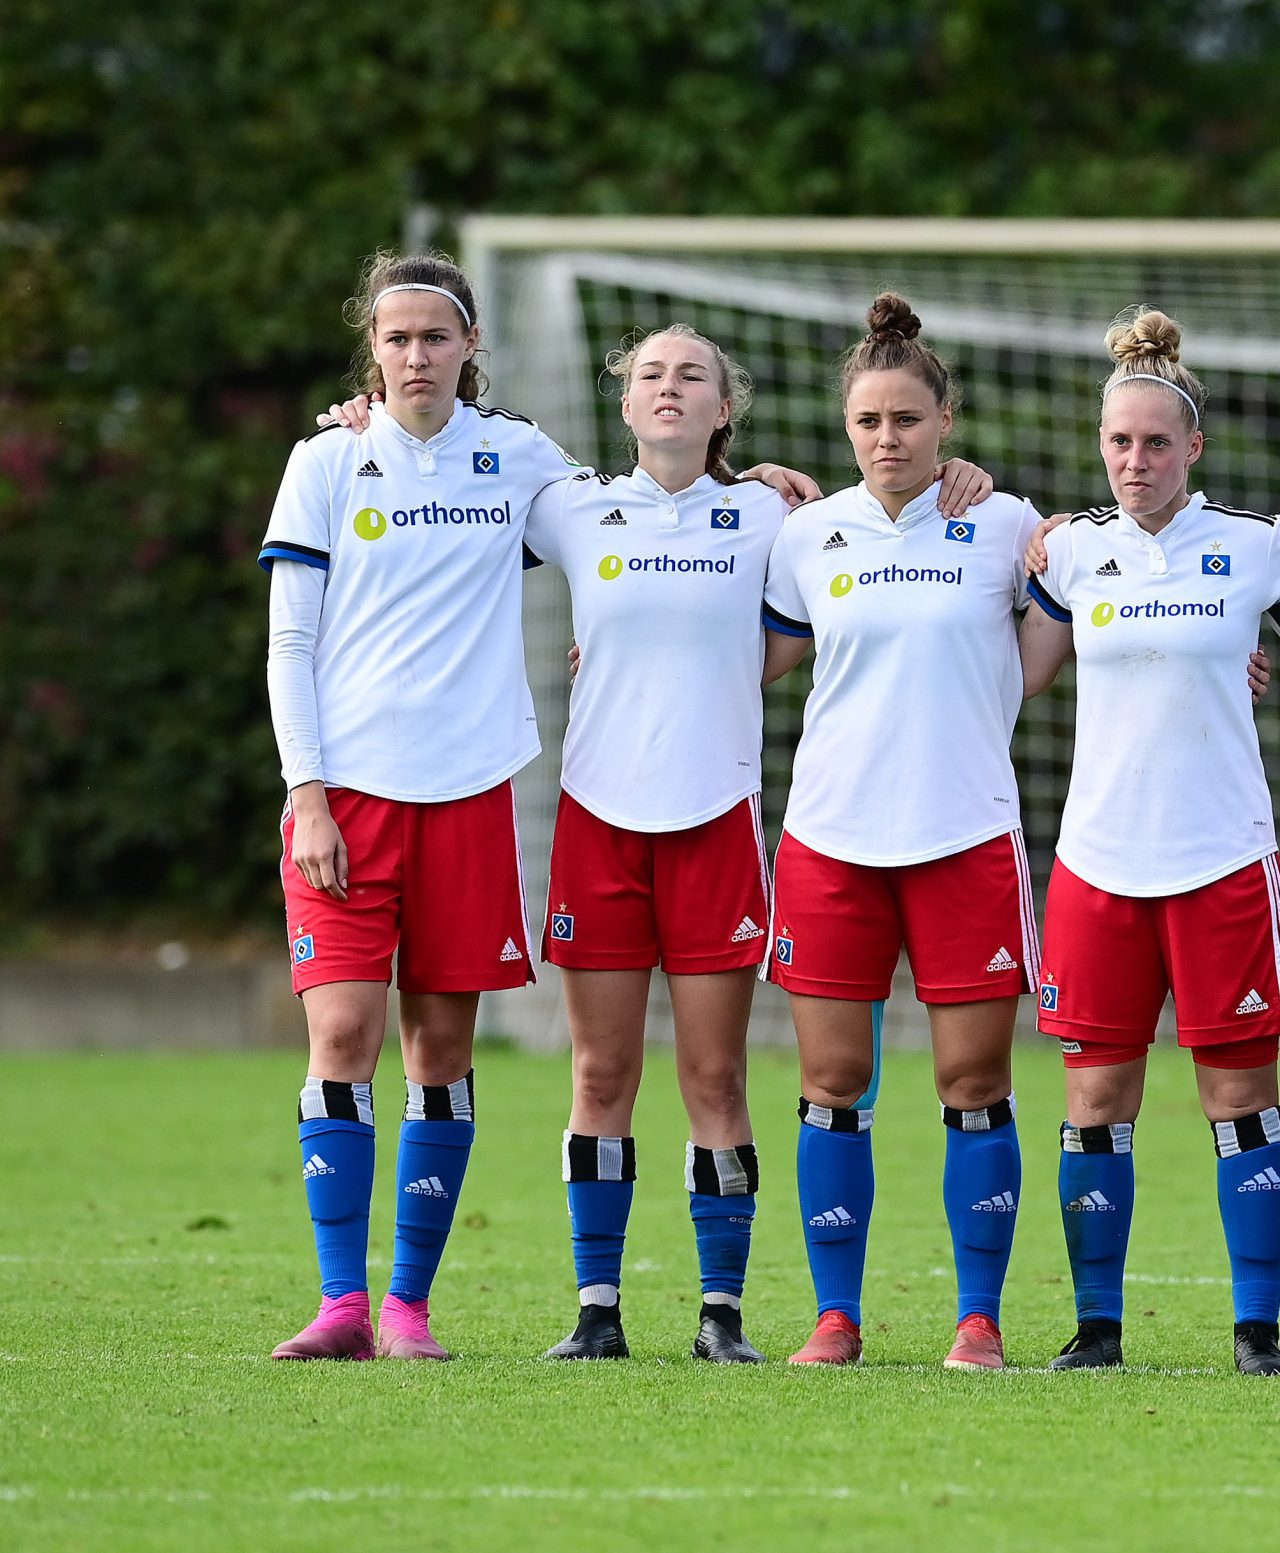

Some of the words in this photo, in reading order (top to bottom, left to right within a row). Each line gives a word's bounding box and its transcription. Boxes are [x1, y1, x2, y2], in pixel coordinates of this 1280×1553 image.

[391, 500, 511, 527] orthomol
[823, 541, 848, 550] adidas
[628, 555, 735, 575] orthomol
[858, 563, 962, 585] orthomol
[1118, 598, 1224, 618] orthomol
[731, 928, 764, 943] adidas
[500, 951, 522, 961] adidas
[987, 960, 1017, 972] adidas
[1236, 1003, 1269, 1015] adidas
[404, 1186, 449, 1199] adidas
[972, 1202, 1016, 1213] adidas
[1066, 1203, 1116, 1212] adidas
[809, 1217, 856, 1227] adidas
